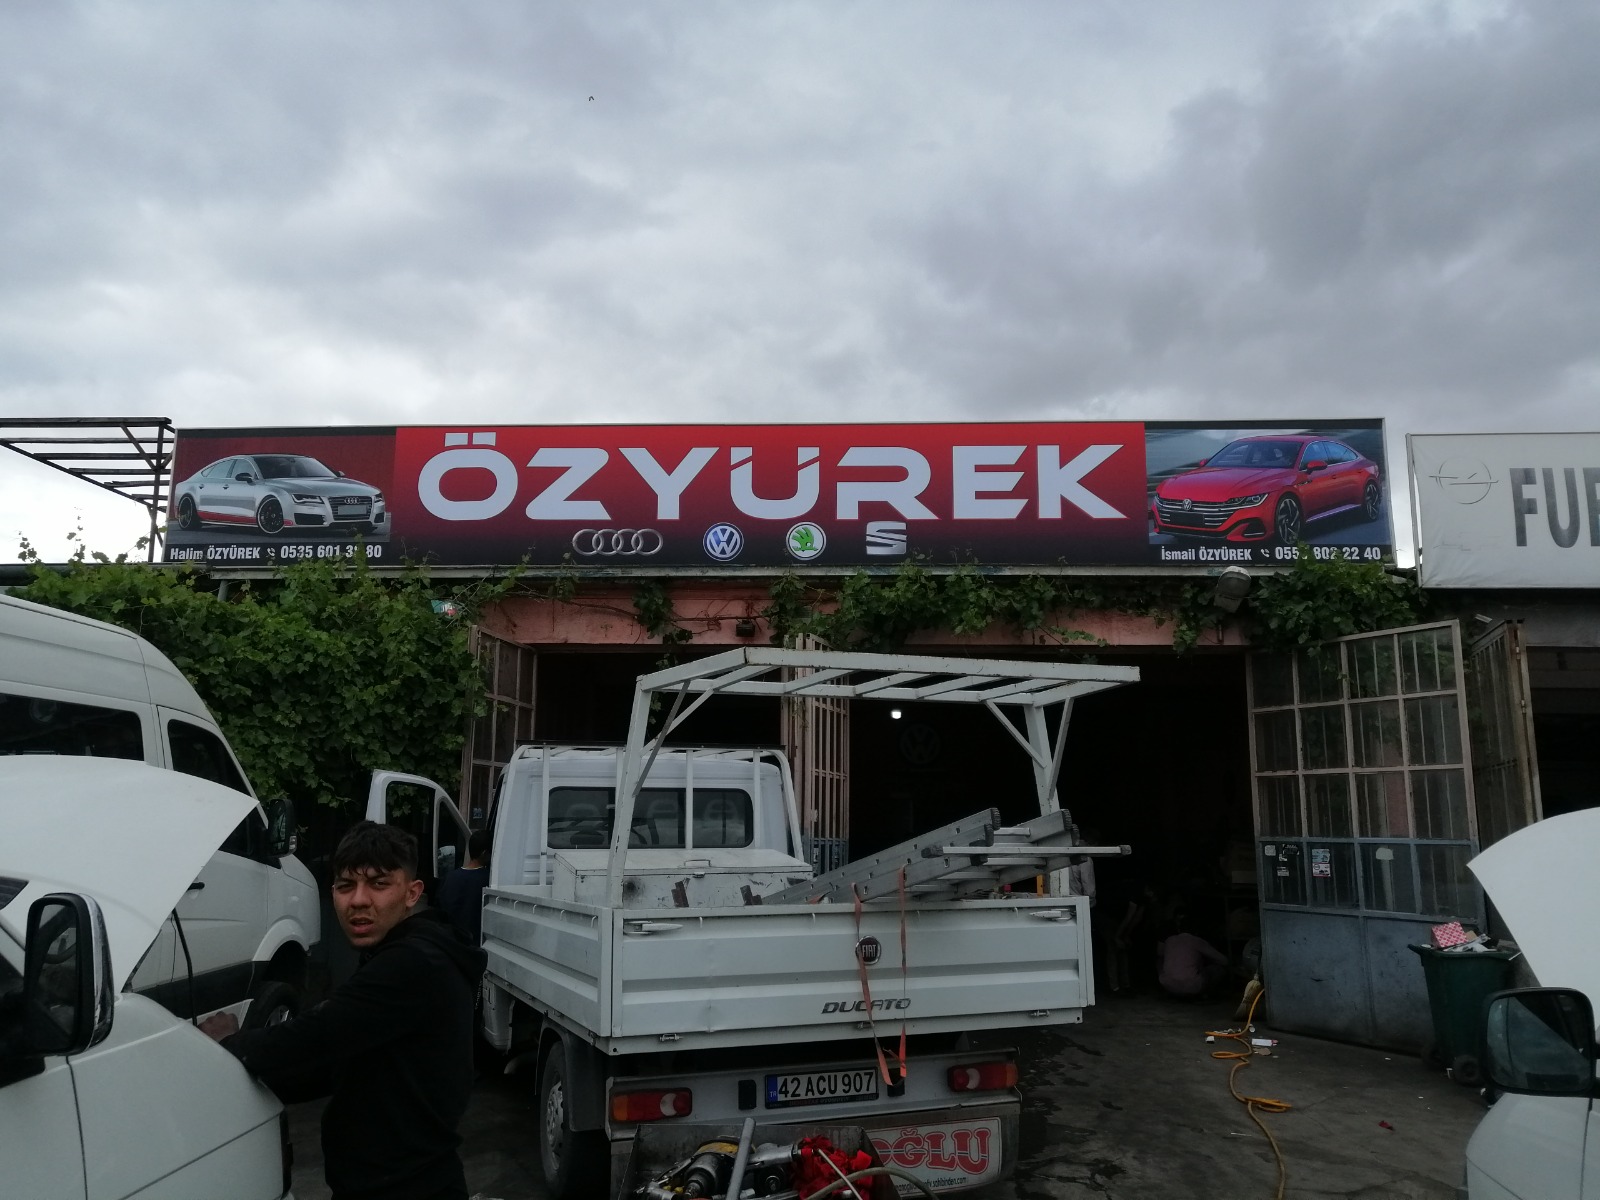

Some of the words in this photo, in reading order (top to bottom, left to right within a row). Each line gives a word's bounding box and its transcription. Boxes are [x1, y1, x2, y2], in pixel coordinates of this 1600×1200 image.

[418, 432, 1129, 521] ÖZYÜREK
[170, 547, 203, 560] Halim
[206, 545, 261, 560] ÖZYÜREK
[280, 545, 313, 558] 0535
[317, 545, 340, 558] 601
[366, 545, 382, 558] 80
[1161, 546, 1196, 560] İsmail
[1199, 546, 1253, 561] ÖZYÜREK
[1275, 546, 1308, 560] 055
[1313, 546, 1338, 560] 802
[1342, 546, 1360, 560] 22
[1363, 546, 1381, 560] 40
[861, 944, 877, 958] FIAT
[821, 998, 911, 1015] DUCATO
[778, 1077, 801, 1098] 42
[804, 1074, 838, 1097] ACU
[841, 1071, 874, 1094] 907
